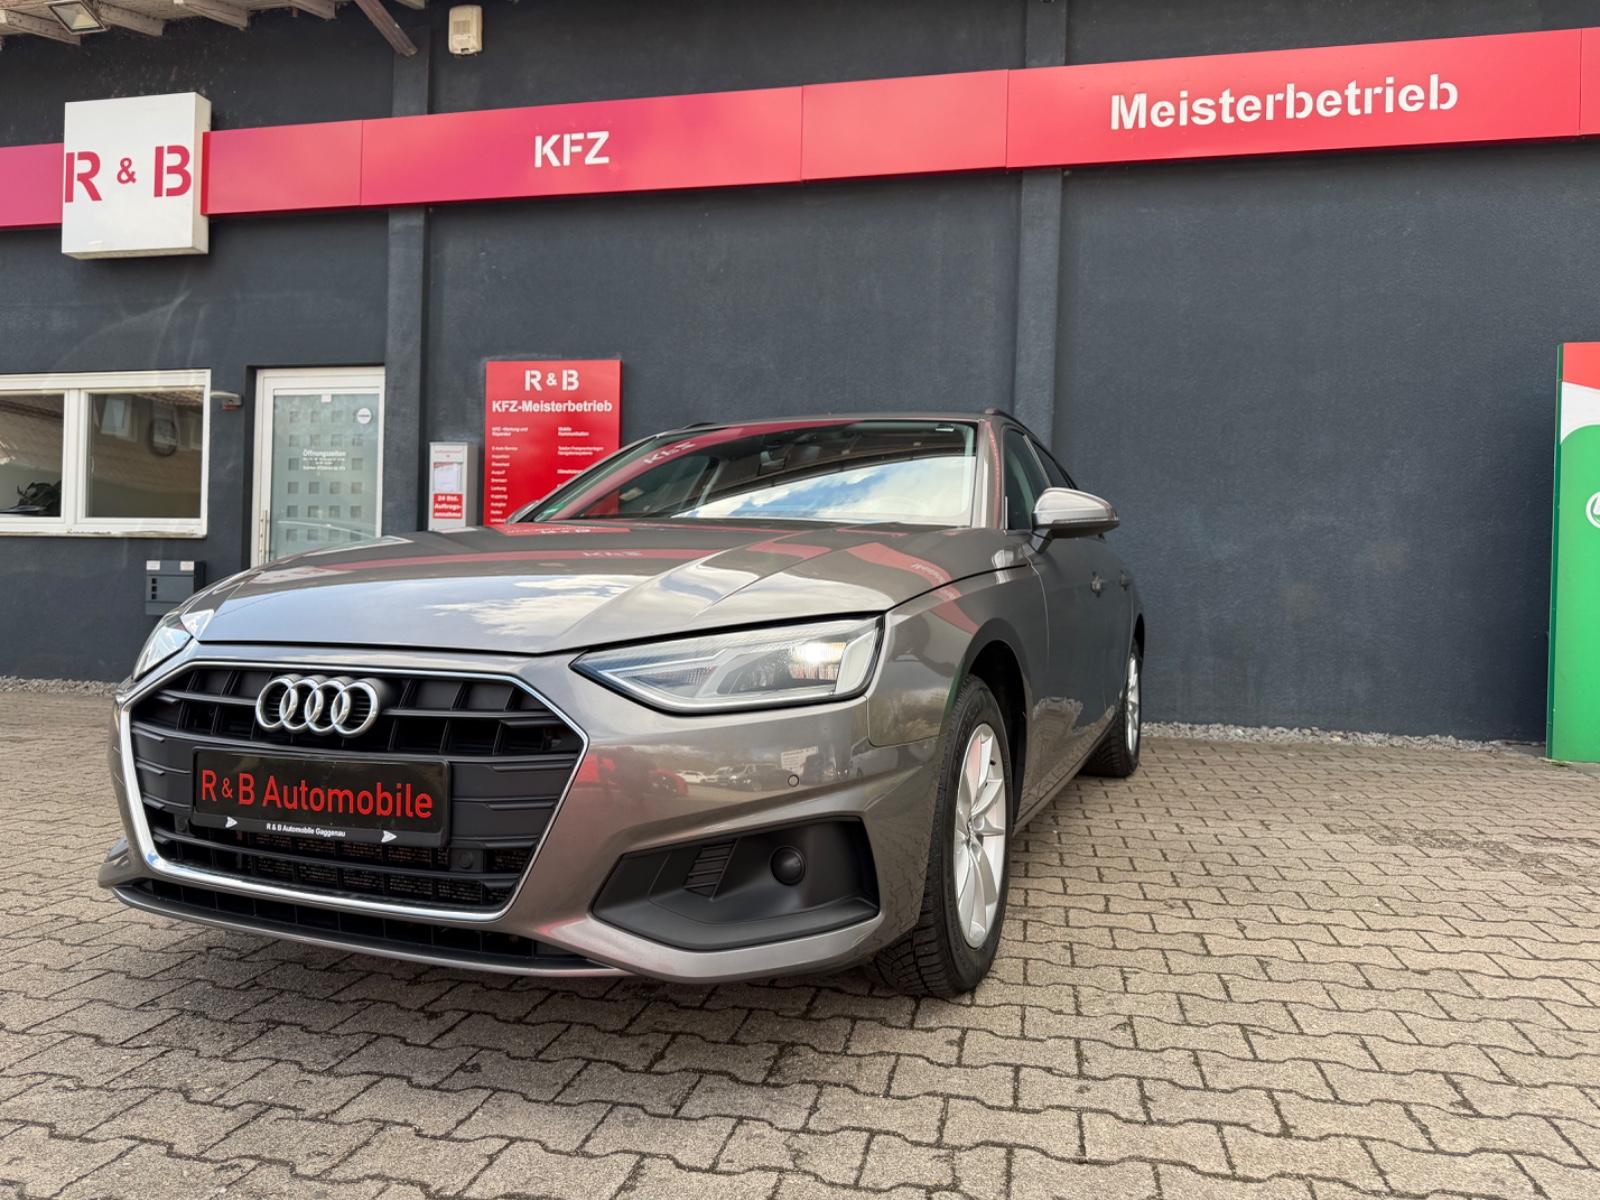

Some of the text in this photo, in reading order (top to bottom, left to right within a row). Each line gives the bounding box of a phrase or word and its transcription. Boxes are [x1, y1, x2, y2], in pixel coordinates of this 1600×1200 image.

[1110, 73, 1459, 131] Meisterbetrieb
[534, 130, 610, 168] KFZ
[64, 144, 192, 203] R & B
[524, 369, 580, 392] R & B
[491, 399, 613, 413] KFZ-Meisterbetrieb
[202, 768, 433, 819] R & B Automobile
[266, 822, 271, 830] R
[282, 825, 315, 835] Automobile
[315, 828, 346, 838] Gaggenau
